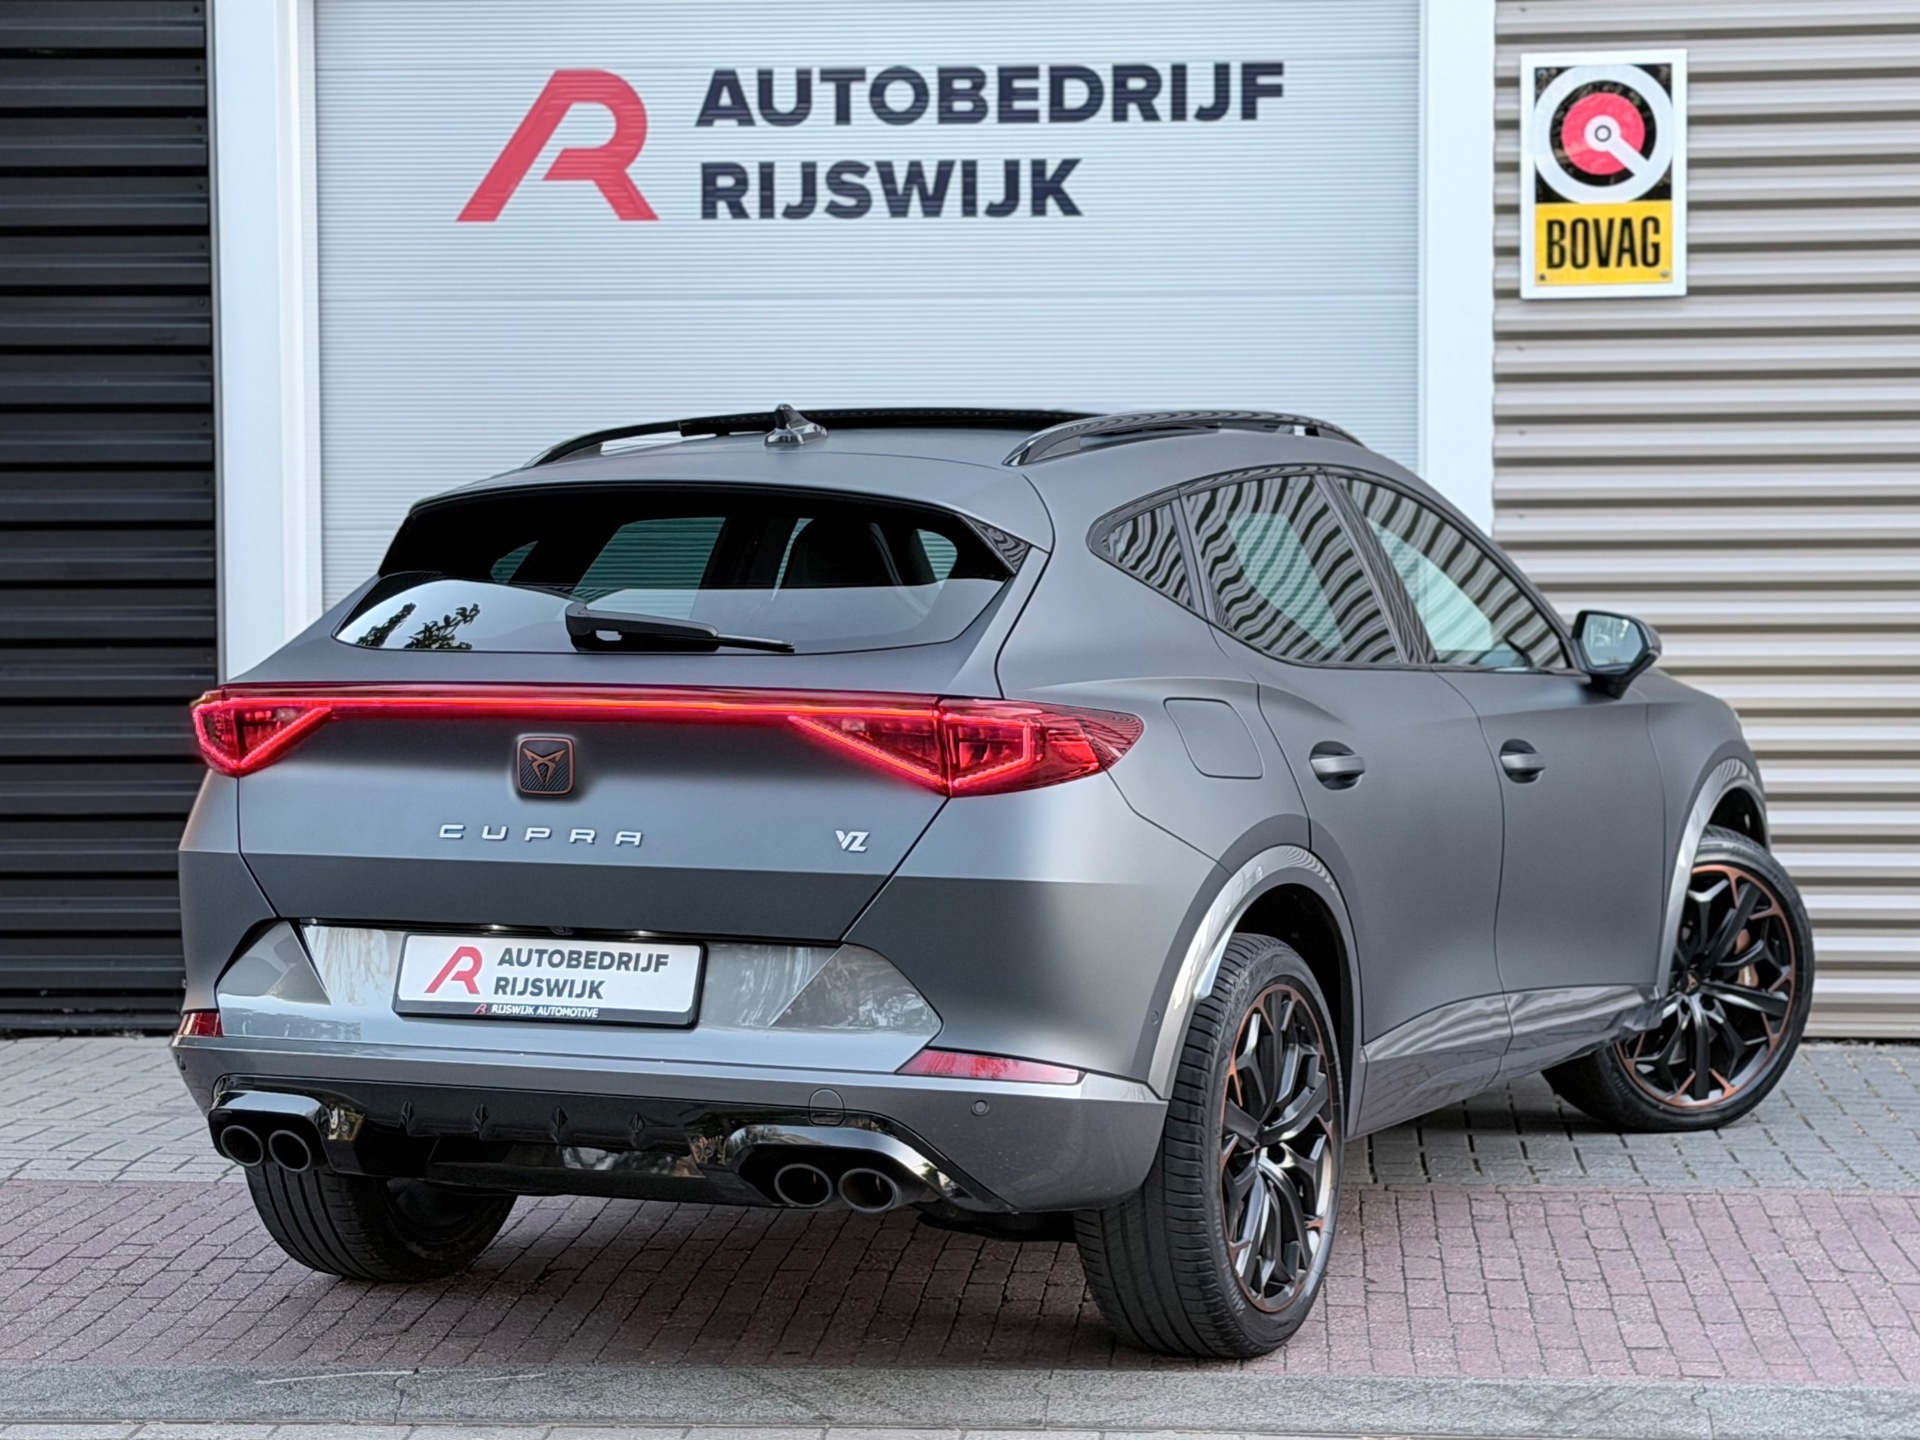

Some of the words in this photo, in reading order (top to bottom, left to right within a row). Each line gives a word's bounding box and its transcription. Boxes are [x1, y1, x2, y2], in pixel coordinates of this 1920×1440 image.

[696, 62, 1285, 127] AUTOBEDRIJF
[700, 159, 1083, 220] RIJSWIJK
[1546, 215, 1661, 270] BOVAG
[438, 823, 644, 847] CUPRA
[835, 829, 870, 852] VZ
[497, 947, 670, 973] AUTOBEDRIJF
[493, 976, 605, 999] RIJSWIJK
[491, 1004, 535, 1015] RIJSWIJK
[536, 1006, 599, 1018] AUTOMOTIVE
